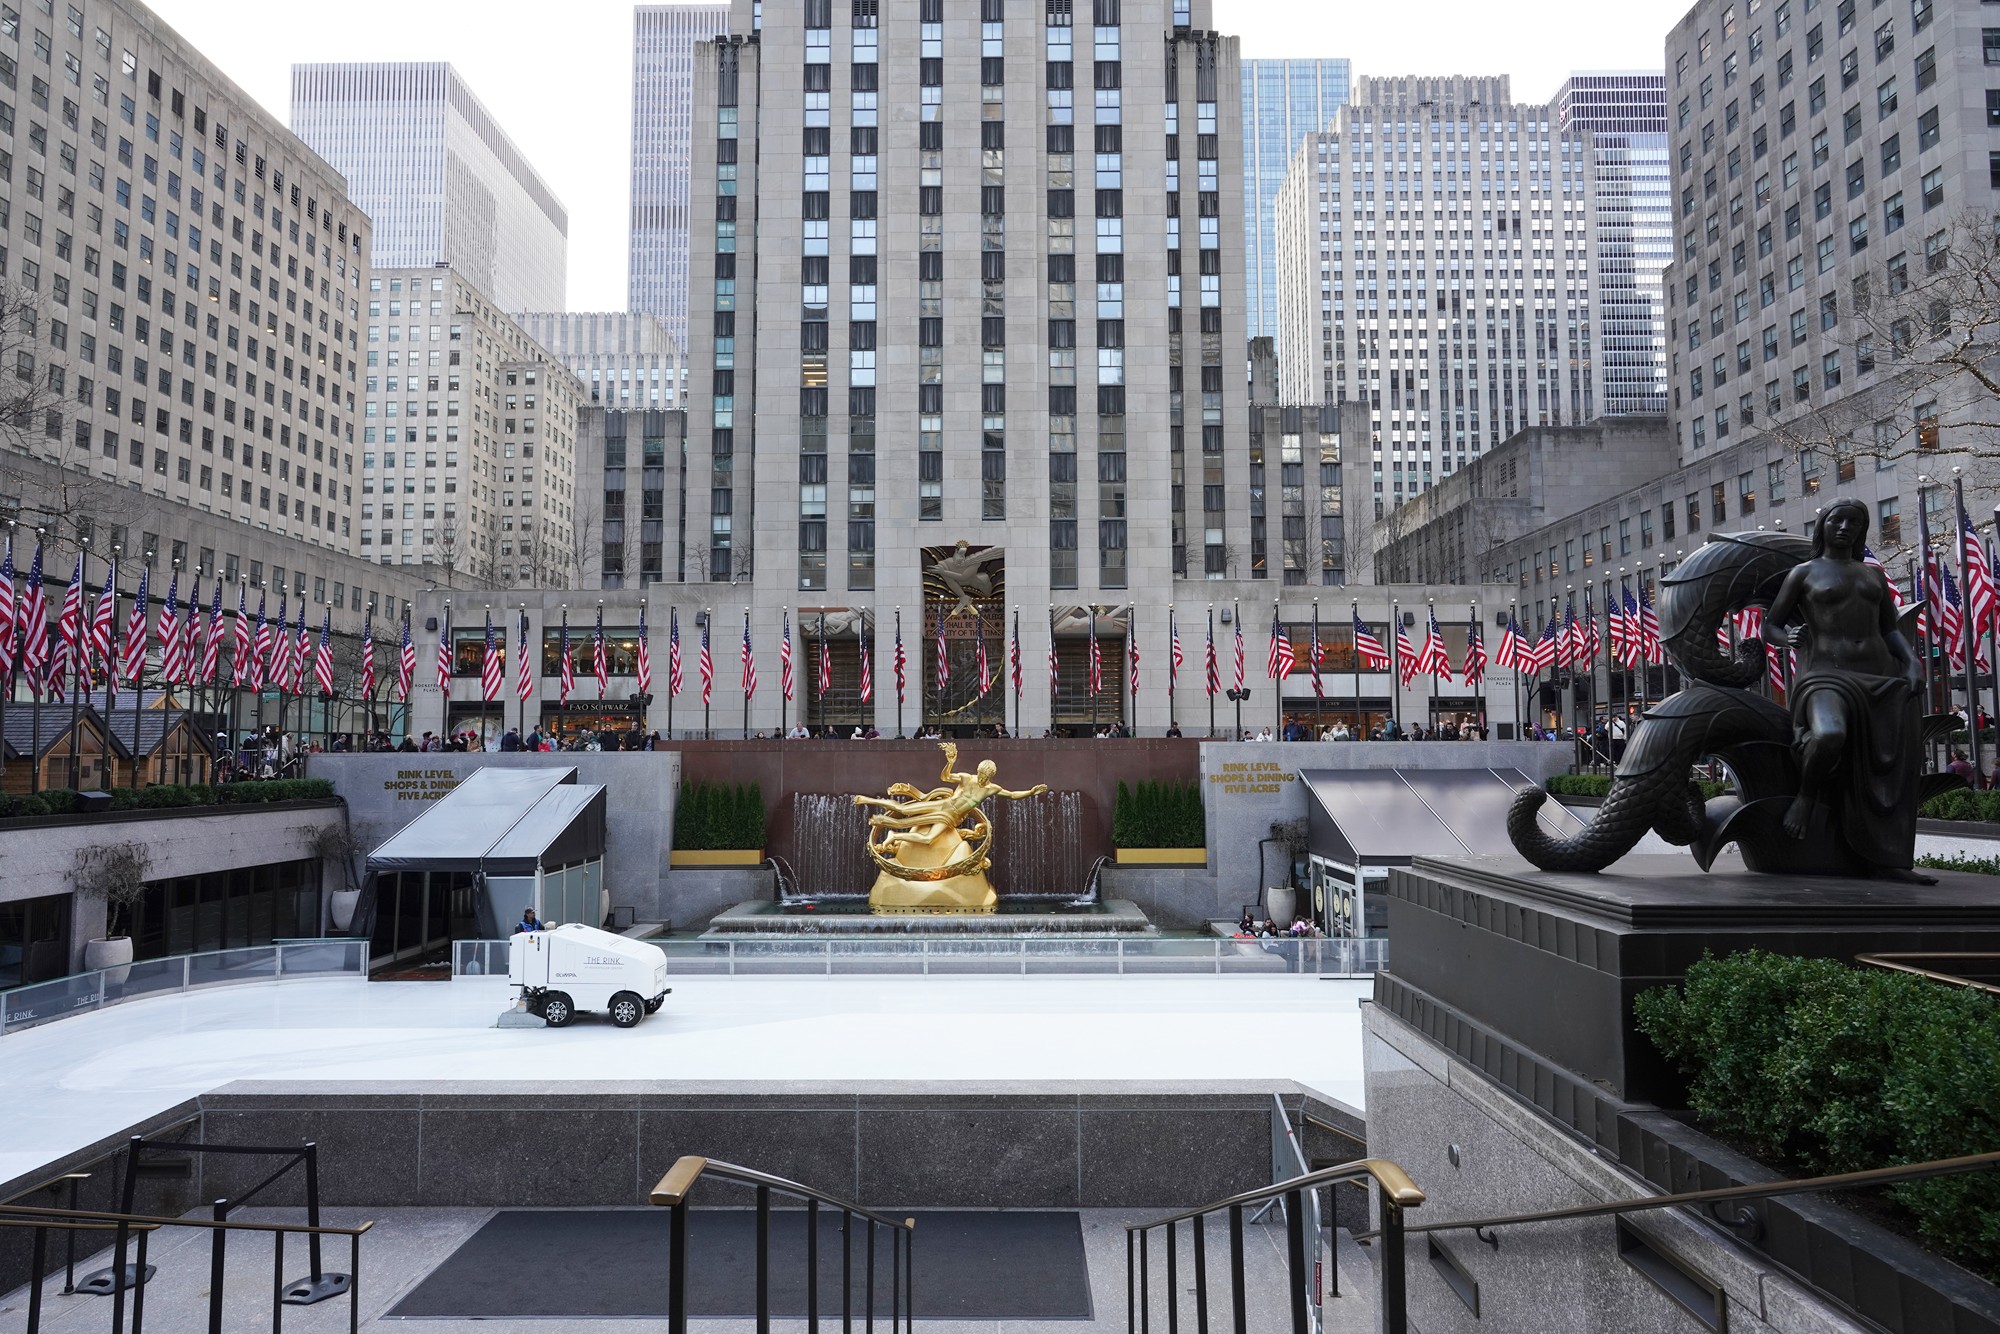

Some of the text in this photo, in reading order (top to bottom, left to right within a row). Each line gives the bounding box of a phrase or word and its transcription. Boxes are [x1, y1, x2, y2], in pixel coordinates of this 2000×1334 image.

[1223, 762, 1281, 772] RINK LEVEL
[398, 770, 454, 779] RINK LEVEL
[1209, 773, 1294, 783] SHOPS & DINING
[384, 781, 461, 790] SHOPS & DININ
[1224, 783, 1281, 794] FIVE ACRES
[398, 792, 419, 800] FIVE
[77, 996, 89, 1005] THE
[14, 1009, 34, 1021] RINK
